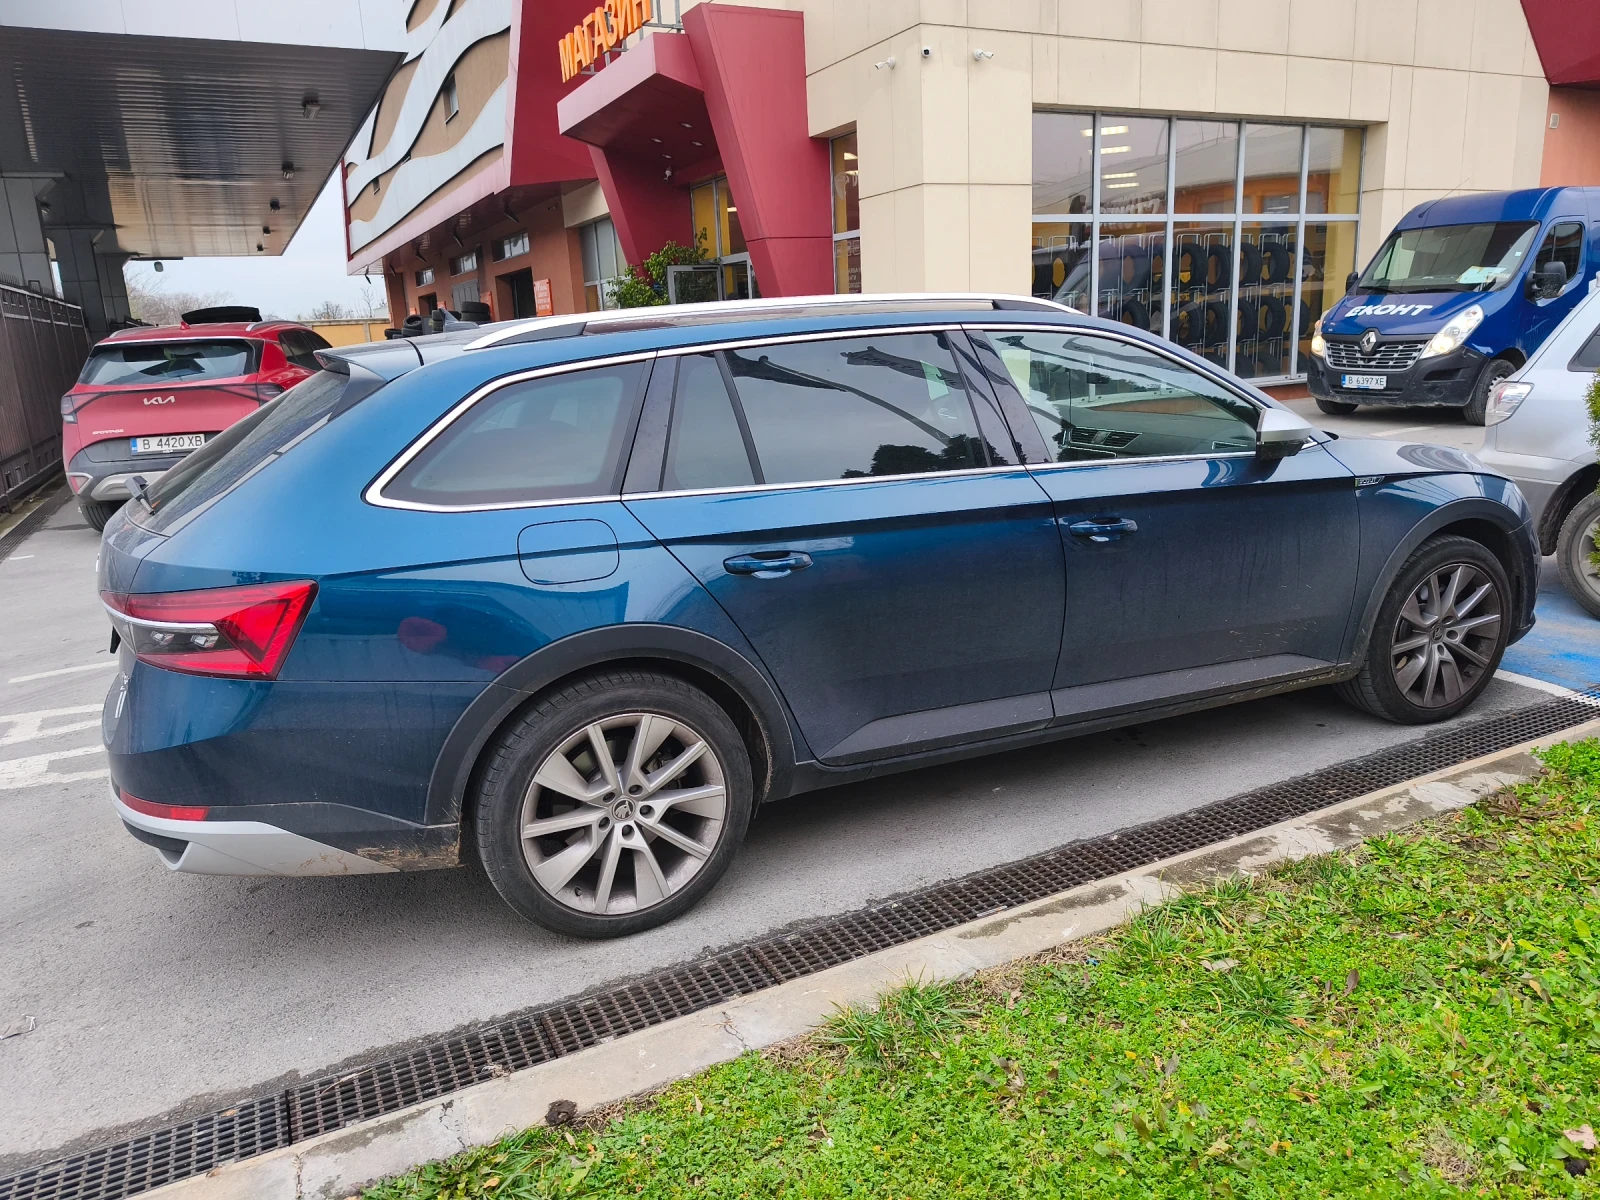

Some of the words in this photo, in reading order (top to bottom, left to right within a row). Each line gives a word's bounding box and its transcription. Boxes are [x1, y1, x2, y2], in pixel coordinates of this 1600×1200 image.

[558, 0, 653, 83] МАГАЗИН
[1344, 304, 1433, 317] ЕКОНТ
[1356, 375, 1374, 386] 6397
[1374, 377, 1385, 386] XE
[142, 439, 151, 450] B
[156, 436, 185, 449] 4420
[187, 435, 203, 447] XB
